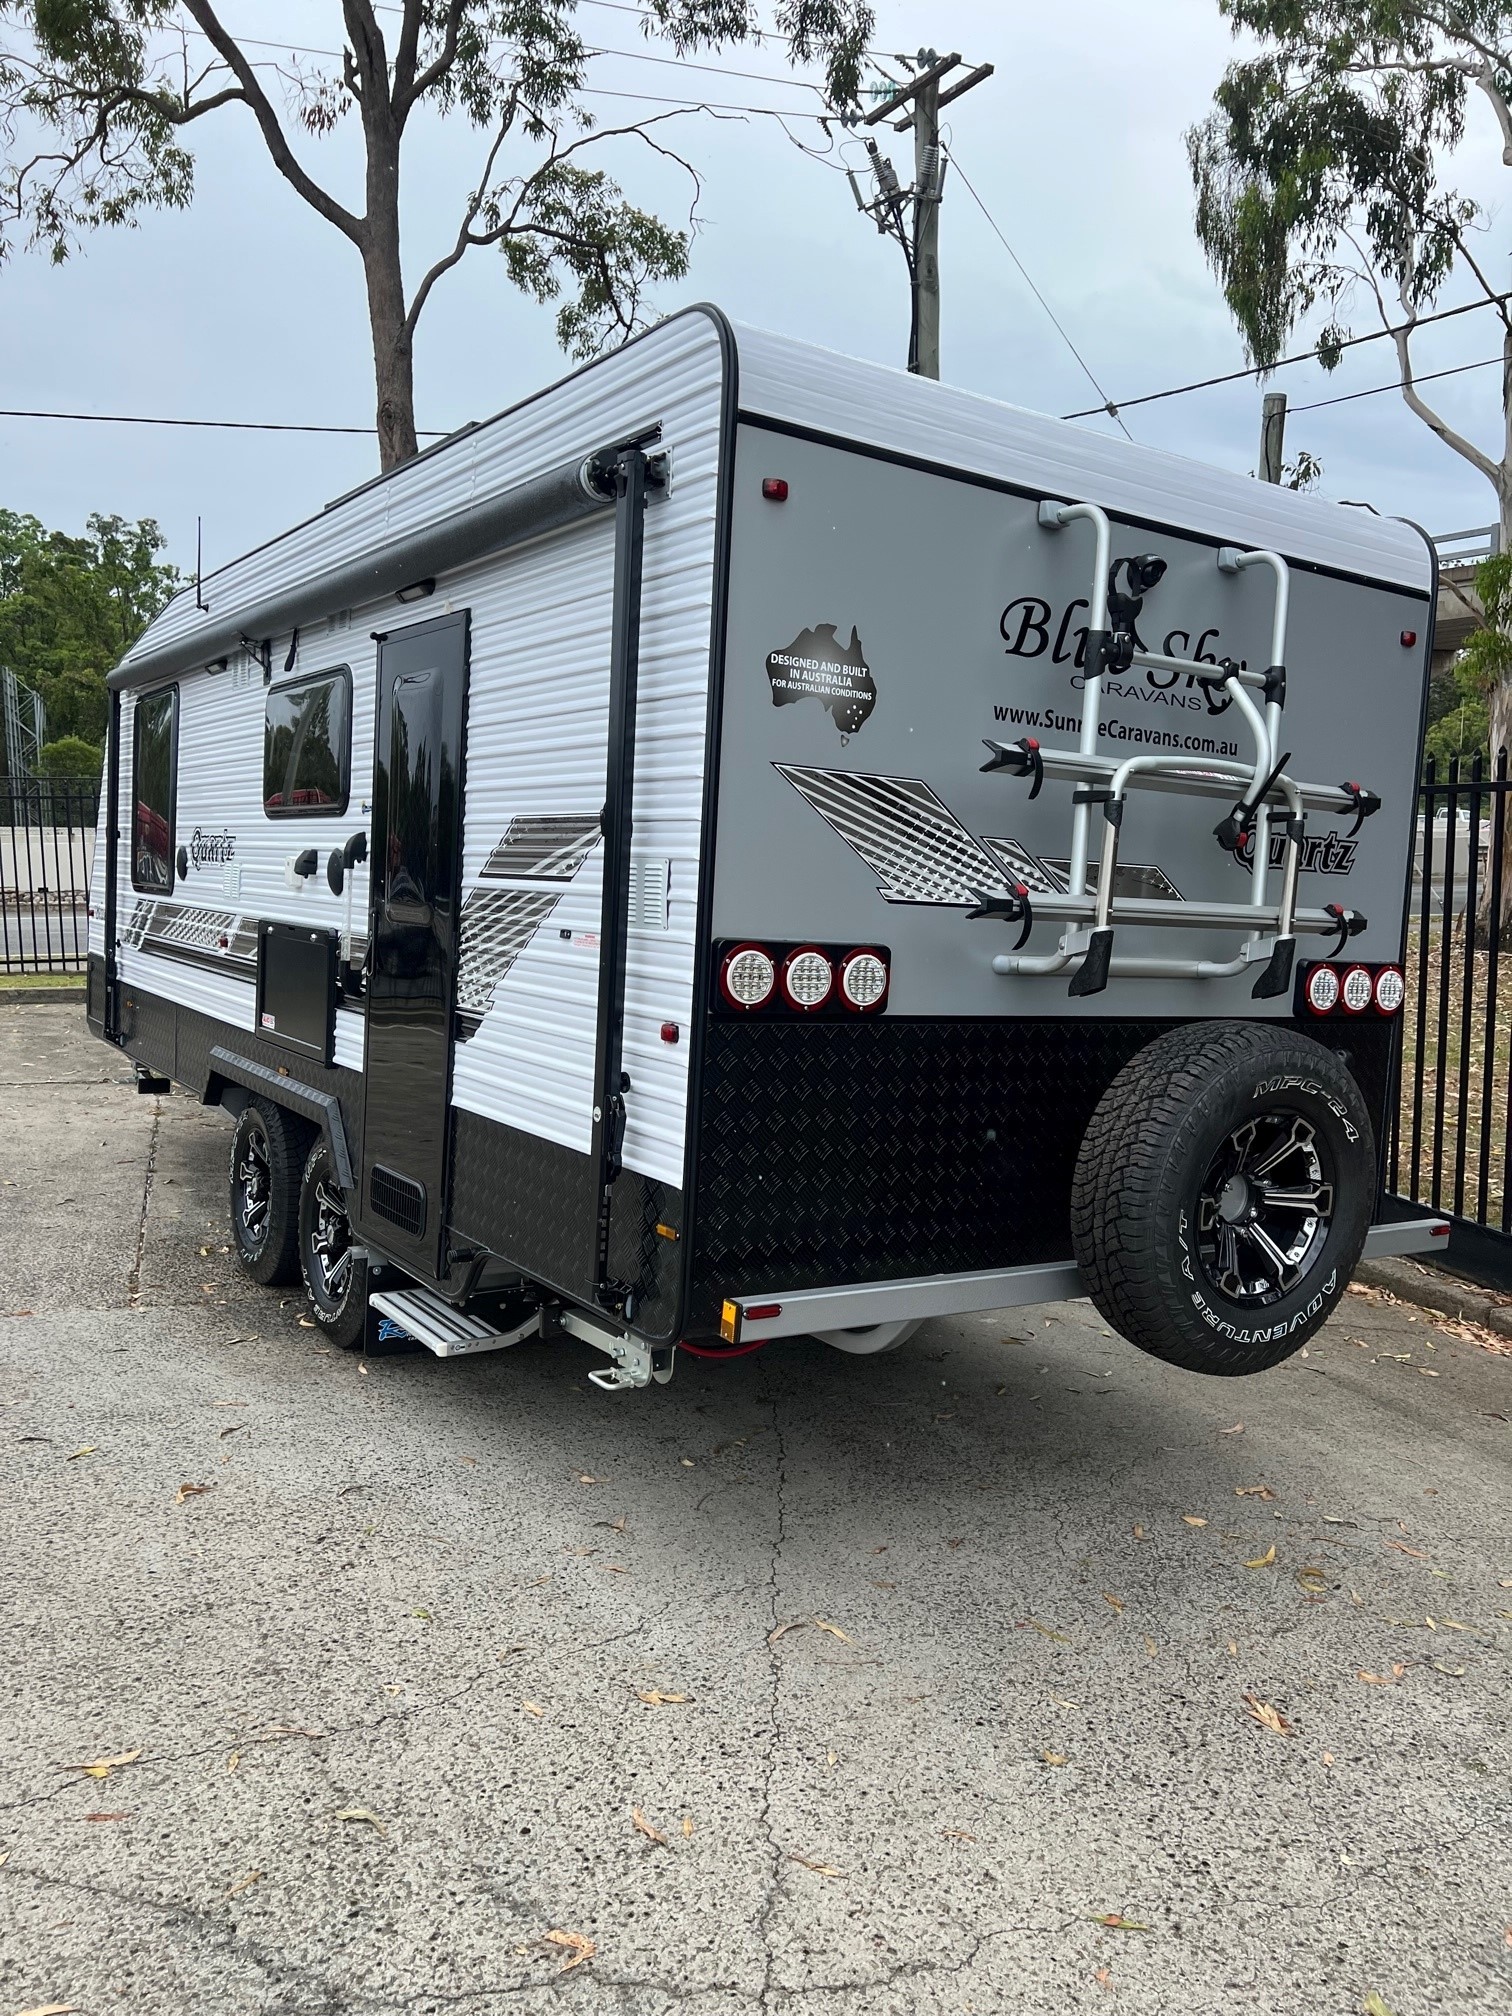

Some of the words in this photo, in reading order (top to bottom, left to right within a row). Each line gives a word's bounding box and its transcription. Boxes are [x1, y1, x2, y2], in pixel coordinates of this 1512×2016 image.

[770, 653, 819, 670] DESIGNED
[820, 661, 841, 674] AND
[842, 664, 868, 678] BUILT
[789, 668, 800, 679] IN
[801, 671, 852, 687] AUSTRALIA
[771, 678, 787, 688] FOR
[787, 681, 830, 695] AUSTRALIAN
[831, 687, 872, 701] CONDITIONS
[1070, 675, 1202, 711] CRAVANS
[993, 705, 1238, 756] www.SunreCaravans.com.au
[1233, 818, 1359, 875] Qurtz
[1253, 1075, 1359, 1143] MPC-24
[1191, 1268, 1337, 1343] ADVENTURE
